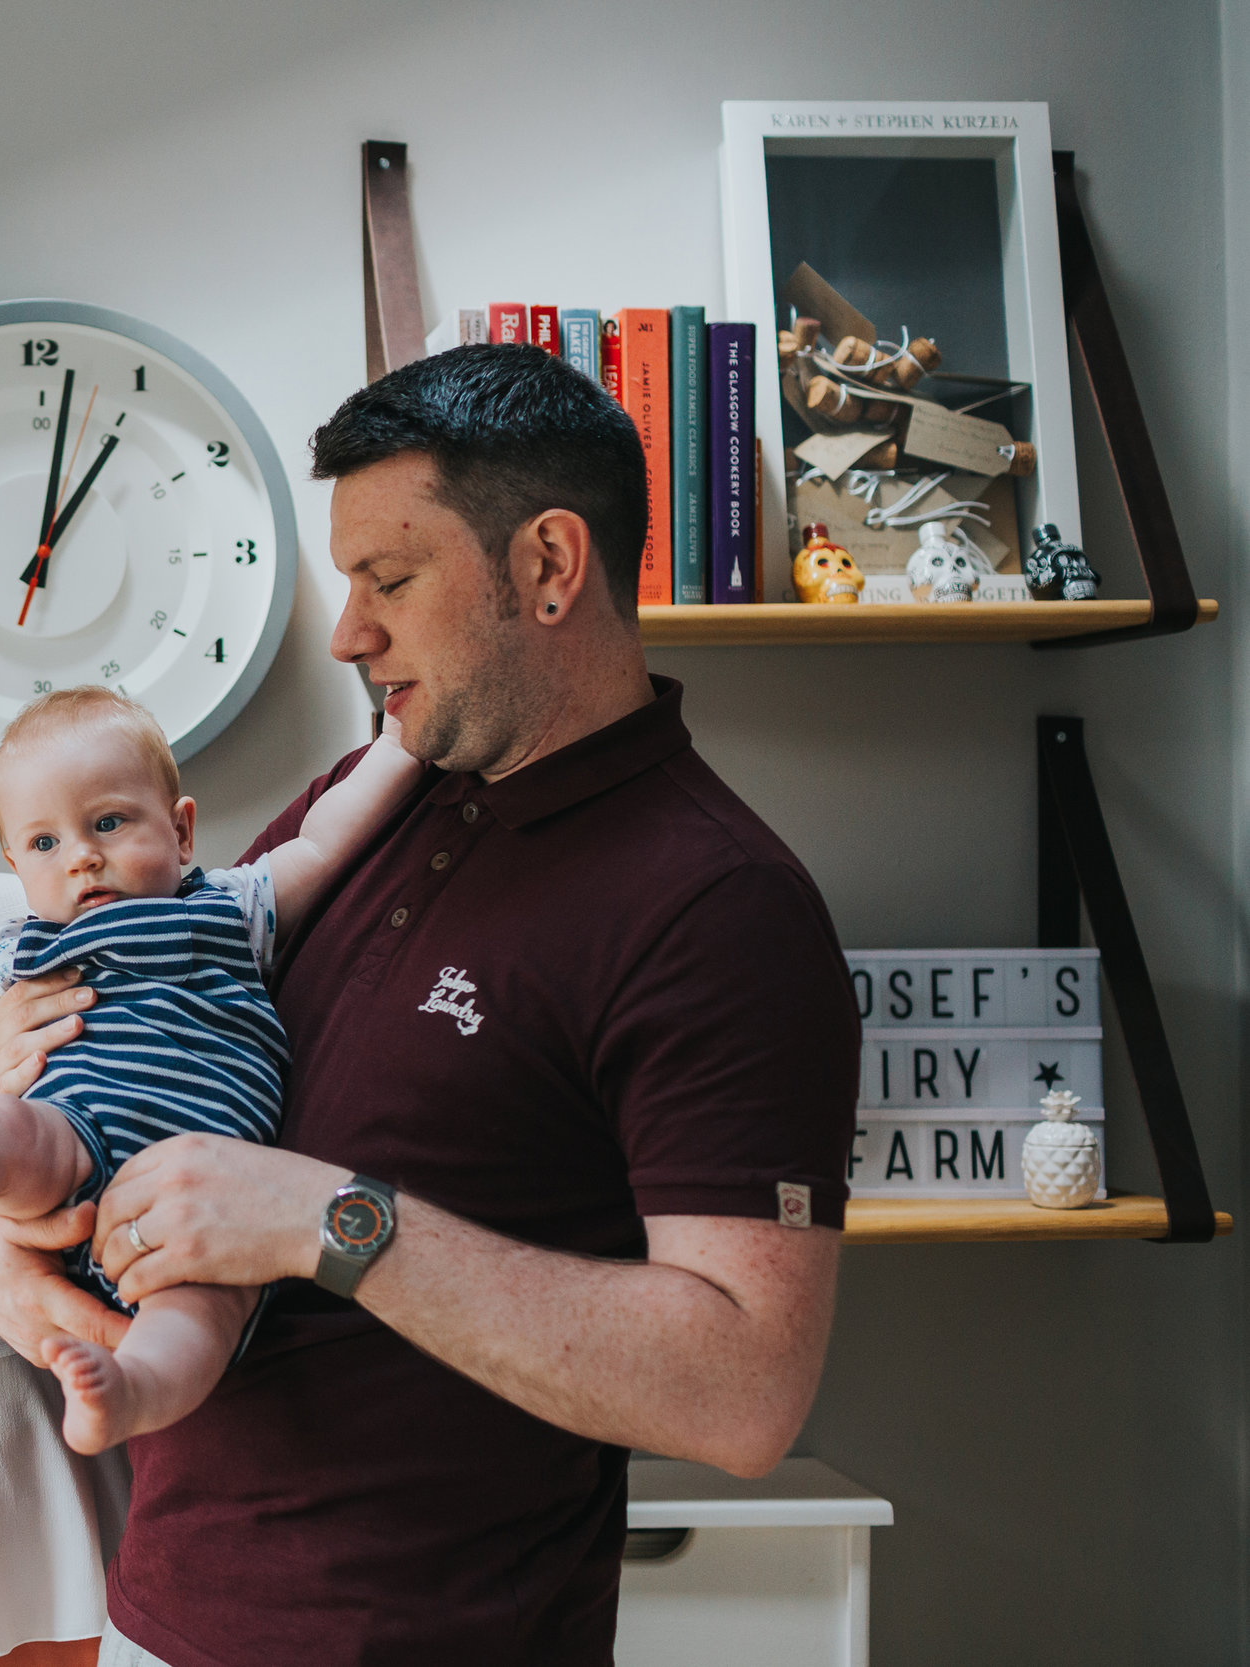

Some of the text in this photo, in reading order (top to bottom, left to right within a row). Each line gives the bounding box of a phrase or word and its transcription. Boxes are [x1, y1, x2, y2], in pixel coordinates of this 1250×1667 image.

[771, 113, 830, 129] KAREN
[854, 114, 934, 129] STEPHEN
[943, 114, 1019, 129] KURZEJA
[538, 314, 551, 345] PHIL
[570, 323, 582, 354] BAKE
[20, 339, 59, 367] 12
[133, 366, 148, 392] 1
[688, 358, 696, 387] FOOD
[642, 361, 651, 449] JAMIE OLIVER
[688, 388, 696, 426] FAMILY
[33, 417, 51, 431] 00
[728, 340, 740, 537] THE GLASGOW COOKERY BOOK
[207, 441, 230, 468] 2
[150, 481, 167, 500] 10
[688, 491, 697, 564] JAMIE OLIVER
[168, 547, 181, 566] 15
[236, 539, 257, 566] 3
[645, 535, 653, 571] FOOD
[150, 610, 168, 630] 20
[204, 638, 228, 664] 4
[101, 660, 120, 678] 25
[34, 680, 52, 694] 30
[433, 966, 477, 1001] Tokyo
[418, 988, 485, 1036] Laundry
[881, 1048, 981, 1099] IRY
[848, 1129, 1005, 1180] FARM
